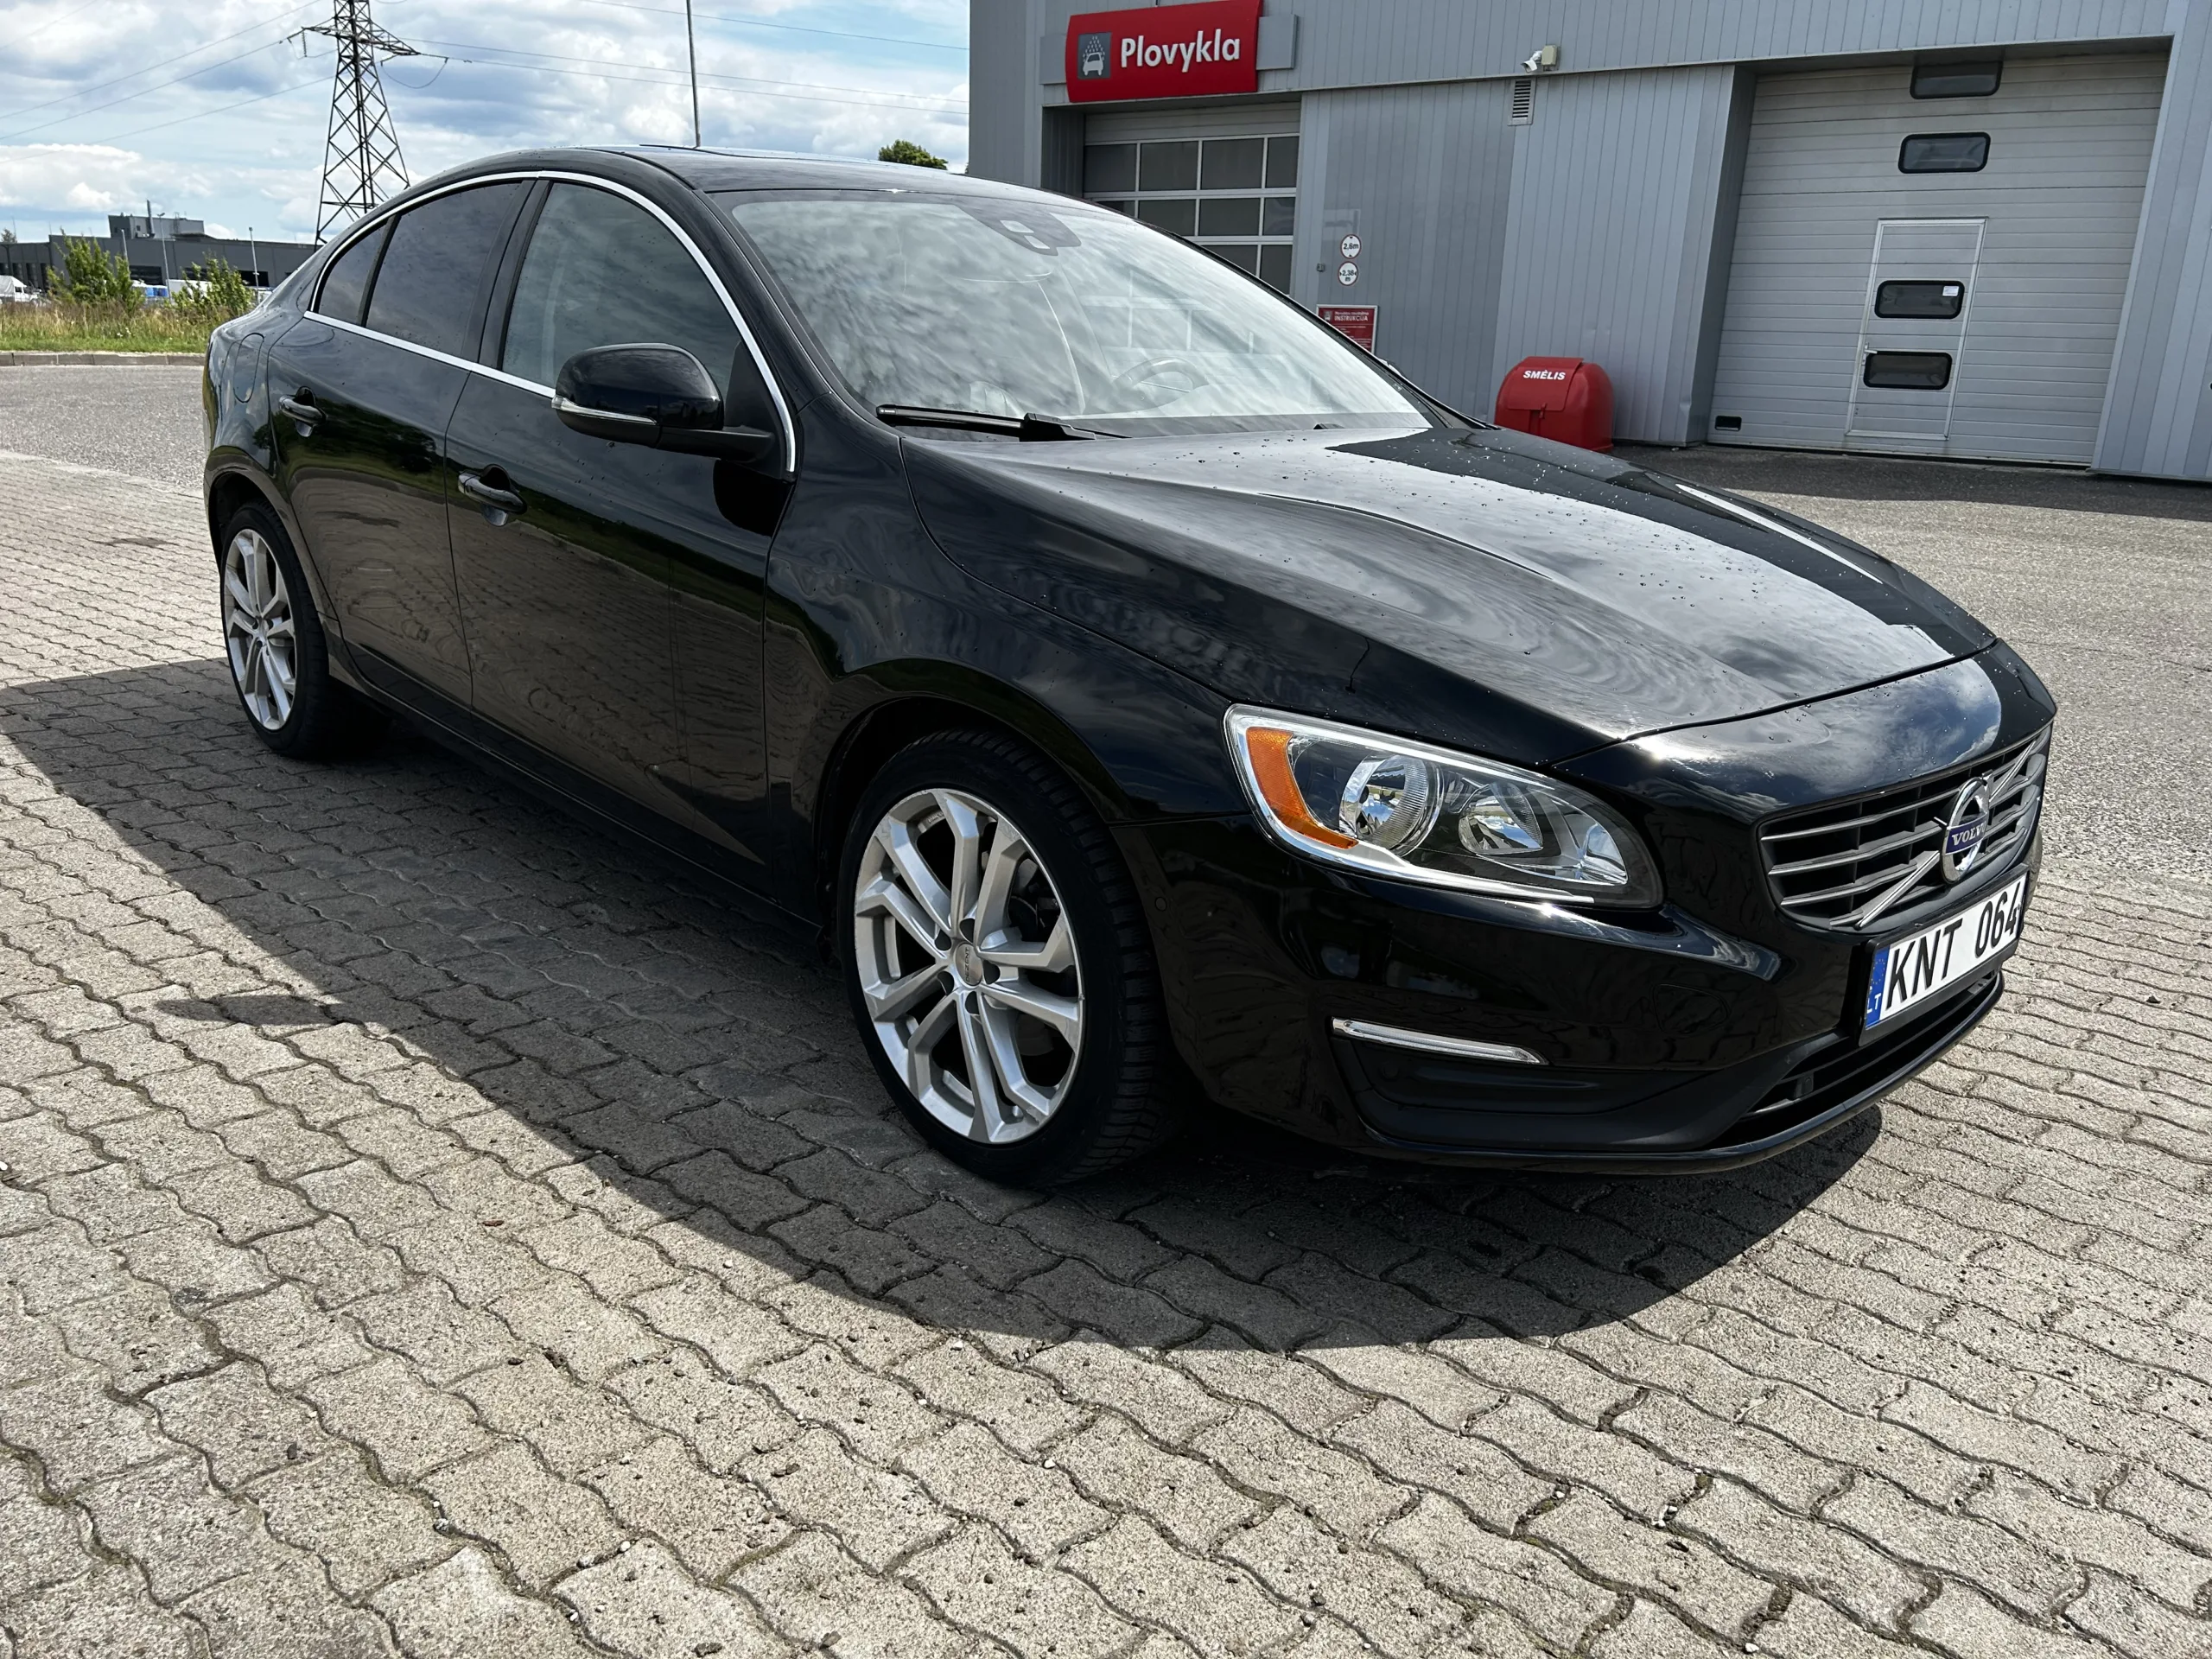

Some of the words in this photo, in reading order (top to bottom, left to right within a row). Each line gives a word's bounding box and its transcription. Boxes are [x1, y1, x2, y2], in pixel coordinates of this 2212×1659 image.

[1121, 29, 1240, 73] Plovykla
[1523, 369, 1566, 380] SMĖLIS
[1885, 918, 1963, 1011] KNT
[1974, 881, 2021, 958] 064
[1866, 993, 1882, 1014] LT
